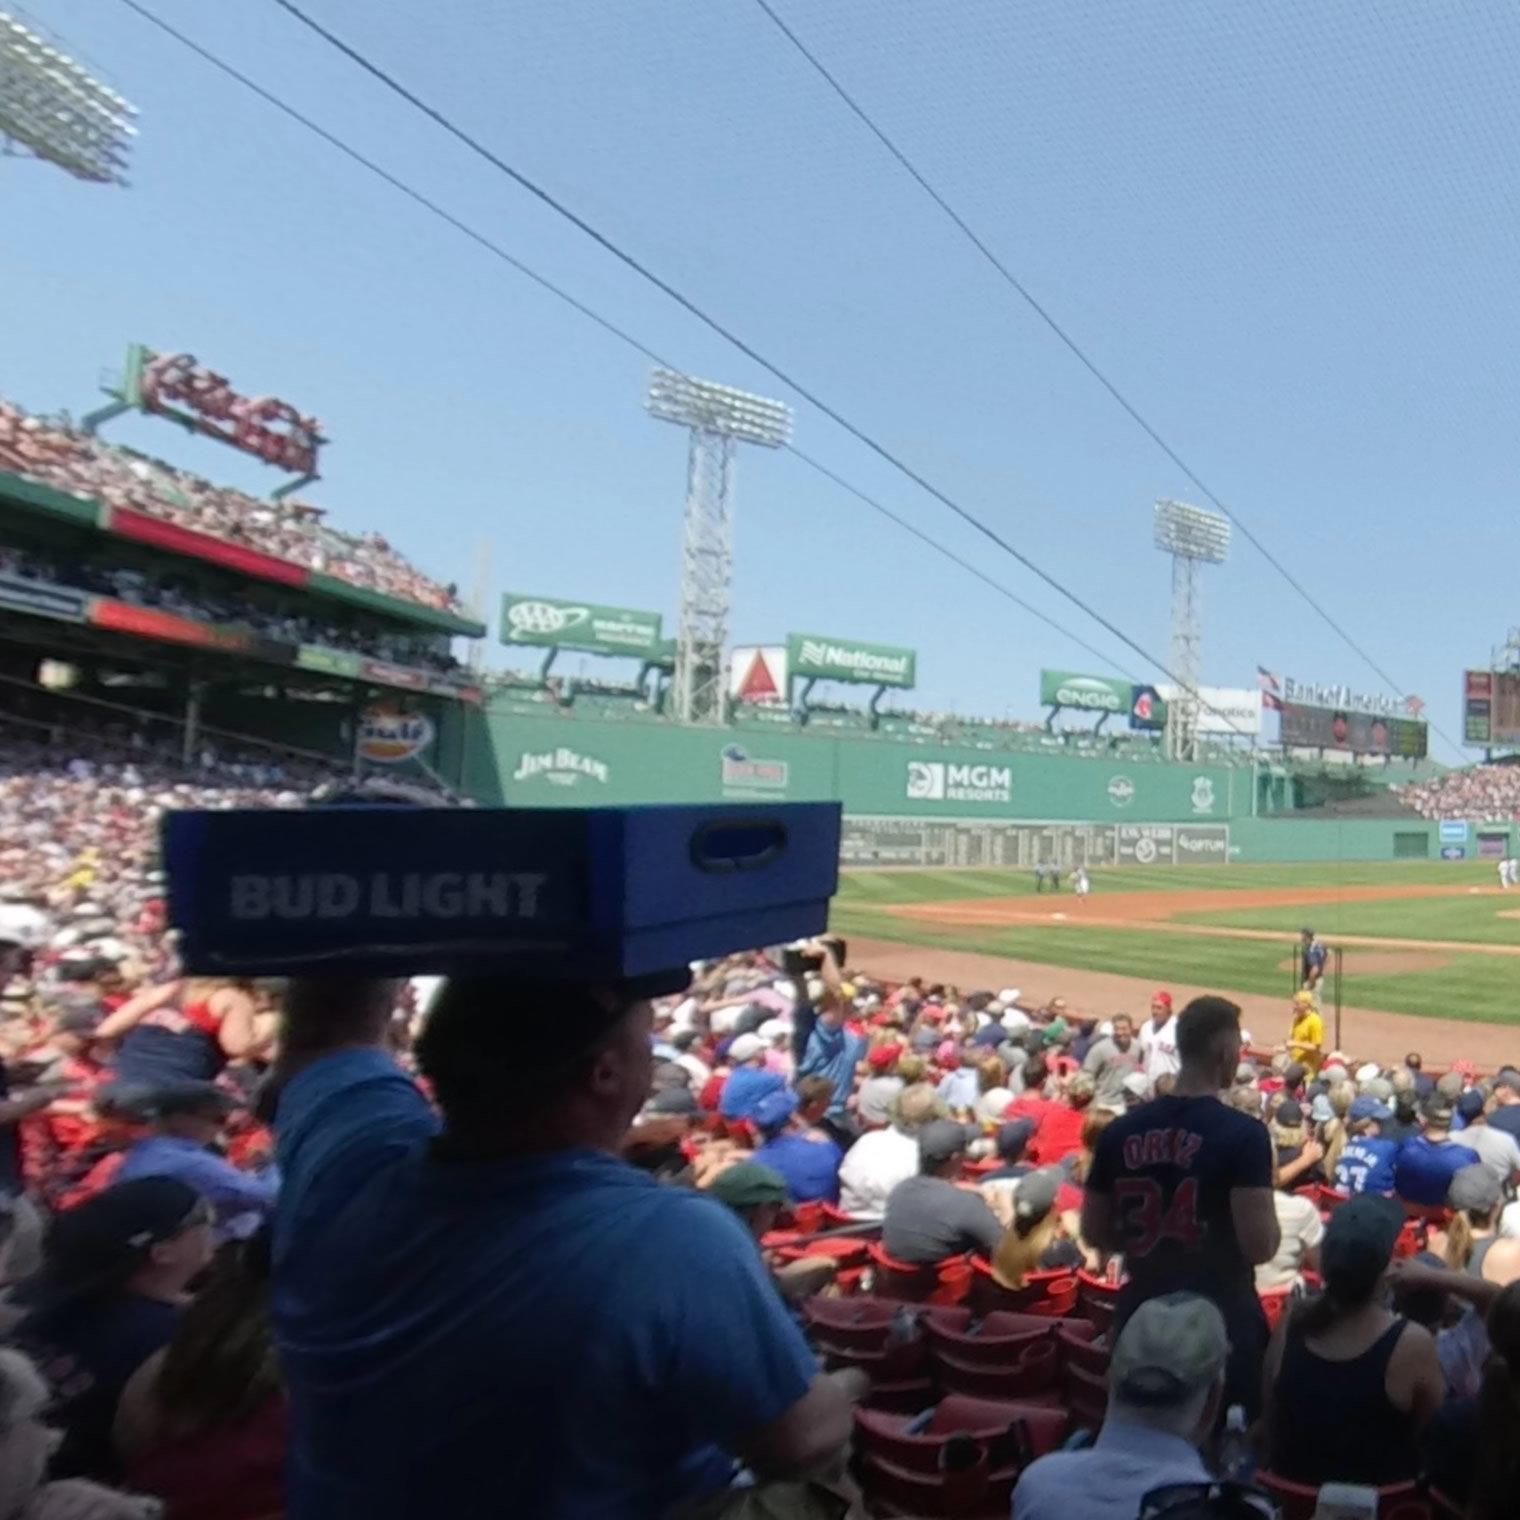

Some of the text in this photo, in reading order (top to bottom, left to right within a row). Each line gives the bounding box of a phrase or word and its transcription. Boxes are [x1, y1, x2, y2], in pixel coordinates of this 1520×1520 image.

[825, 645, 906, 673] National
[1285, 677, 1402, 713] Bank of America
[513, 747, 608, 783] JIM BEAM
[947, 763, 1011, 788] MGM
[946, 786, 1011, 802] RESORTS
[1189, 839, 1224, 851] OPTUM
[231, 873, 547, 919] BUD LIGHT
[1123, 1127, 1203, 1170] ORTIZ
[1114, 1176, 1209, 1258] 34
